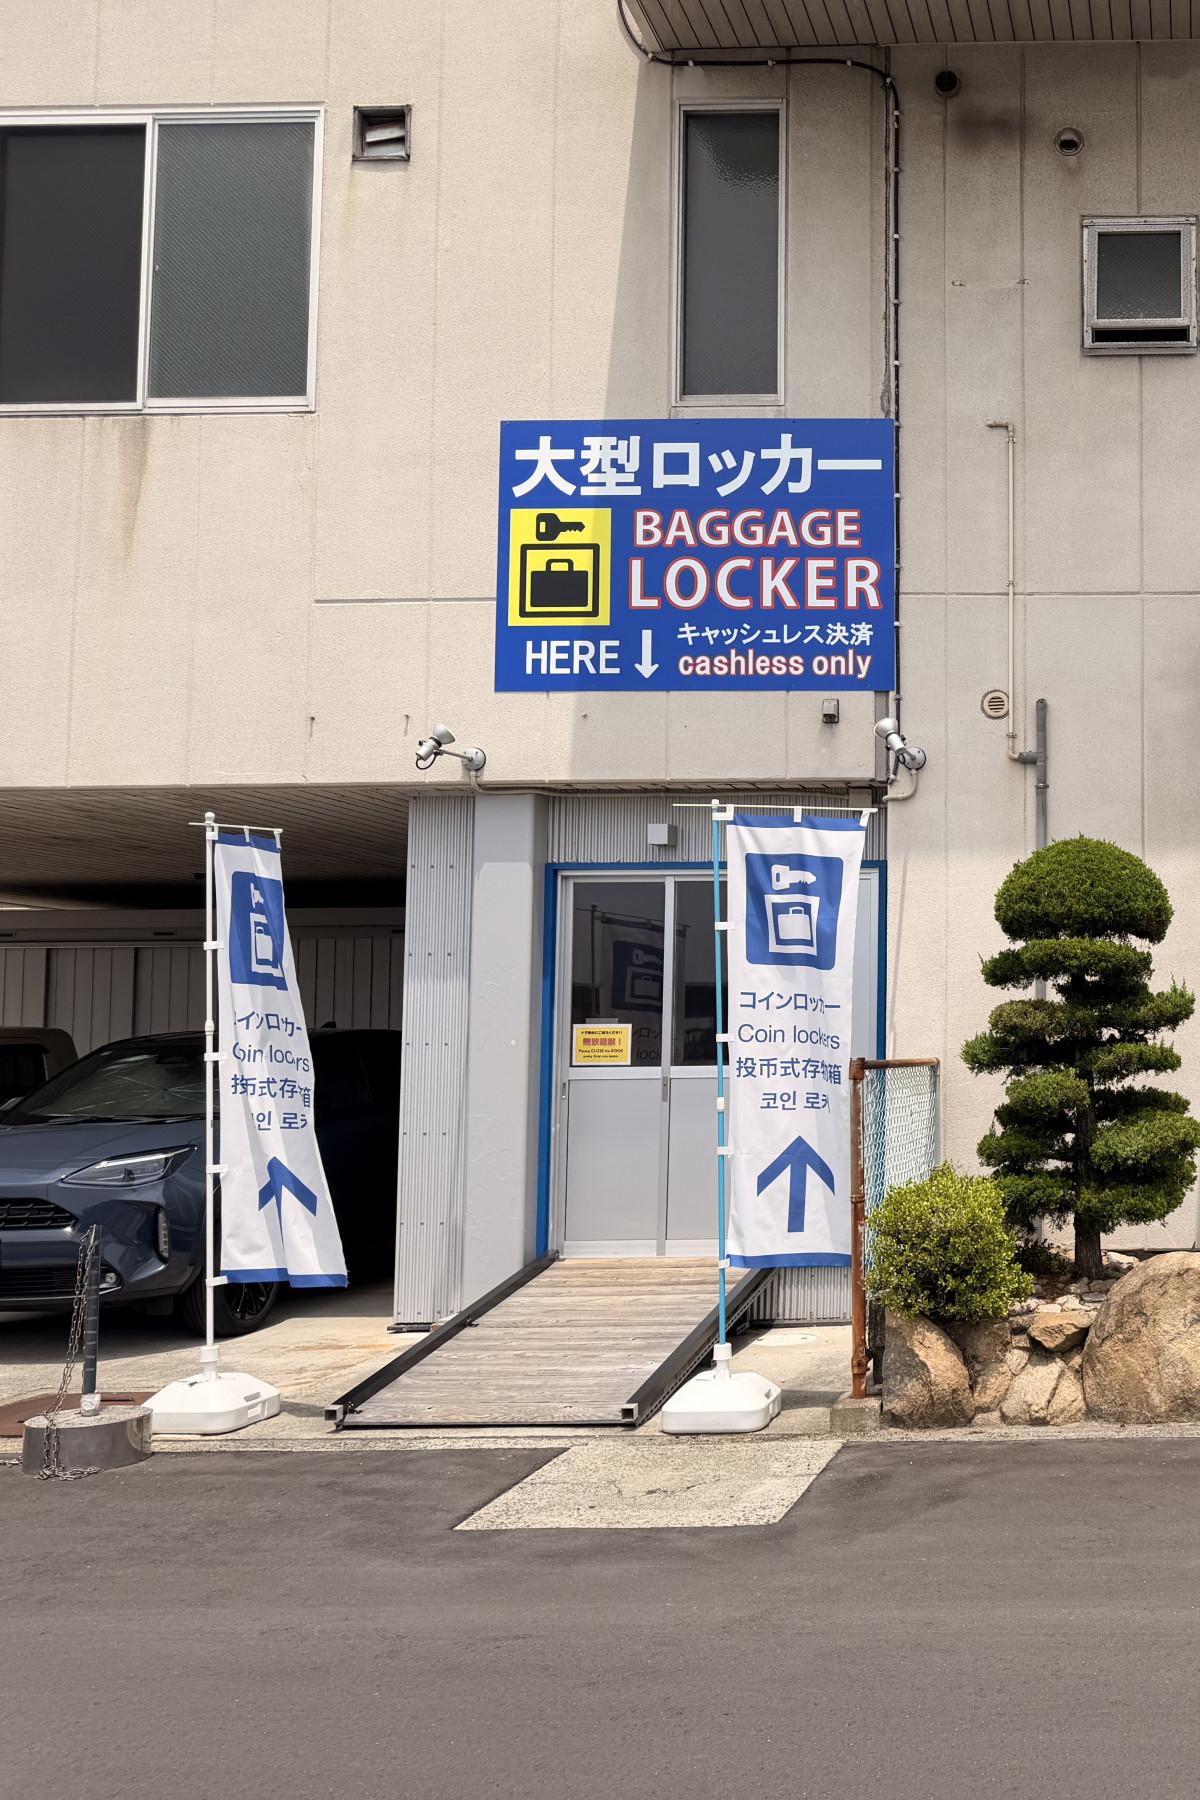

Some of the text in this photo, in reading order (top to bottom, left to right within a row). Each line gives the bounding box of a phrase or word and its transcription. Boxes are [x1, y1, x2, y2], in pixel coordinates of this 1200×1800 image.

[511, 433, 882, 498] 大型ロッカー
[633, 508, 862, 547] BAGGAGE
[628, 556, 882, 610] LOCKER
[677, 622, 873, 646] キャッシュレス決済
[525, 639, 621, 675] HERE
[678, 648, 872, 679] cashless only
[739, 991, 841, 1015] コインロッカー
[737, 1023, 840, 1050] Coin lockers
[269, 1044, 310, 1073] locrs
[760, 1090, 797, 1111] 코인
